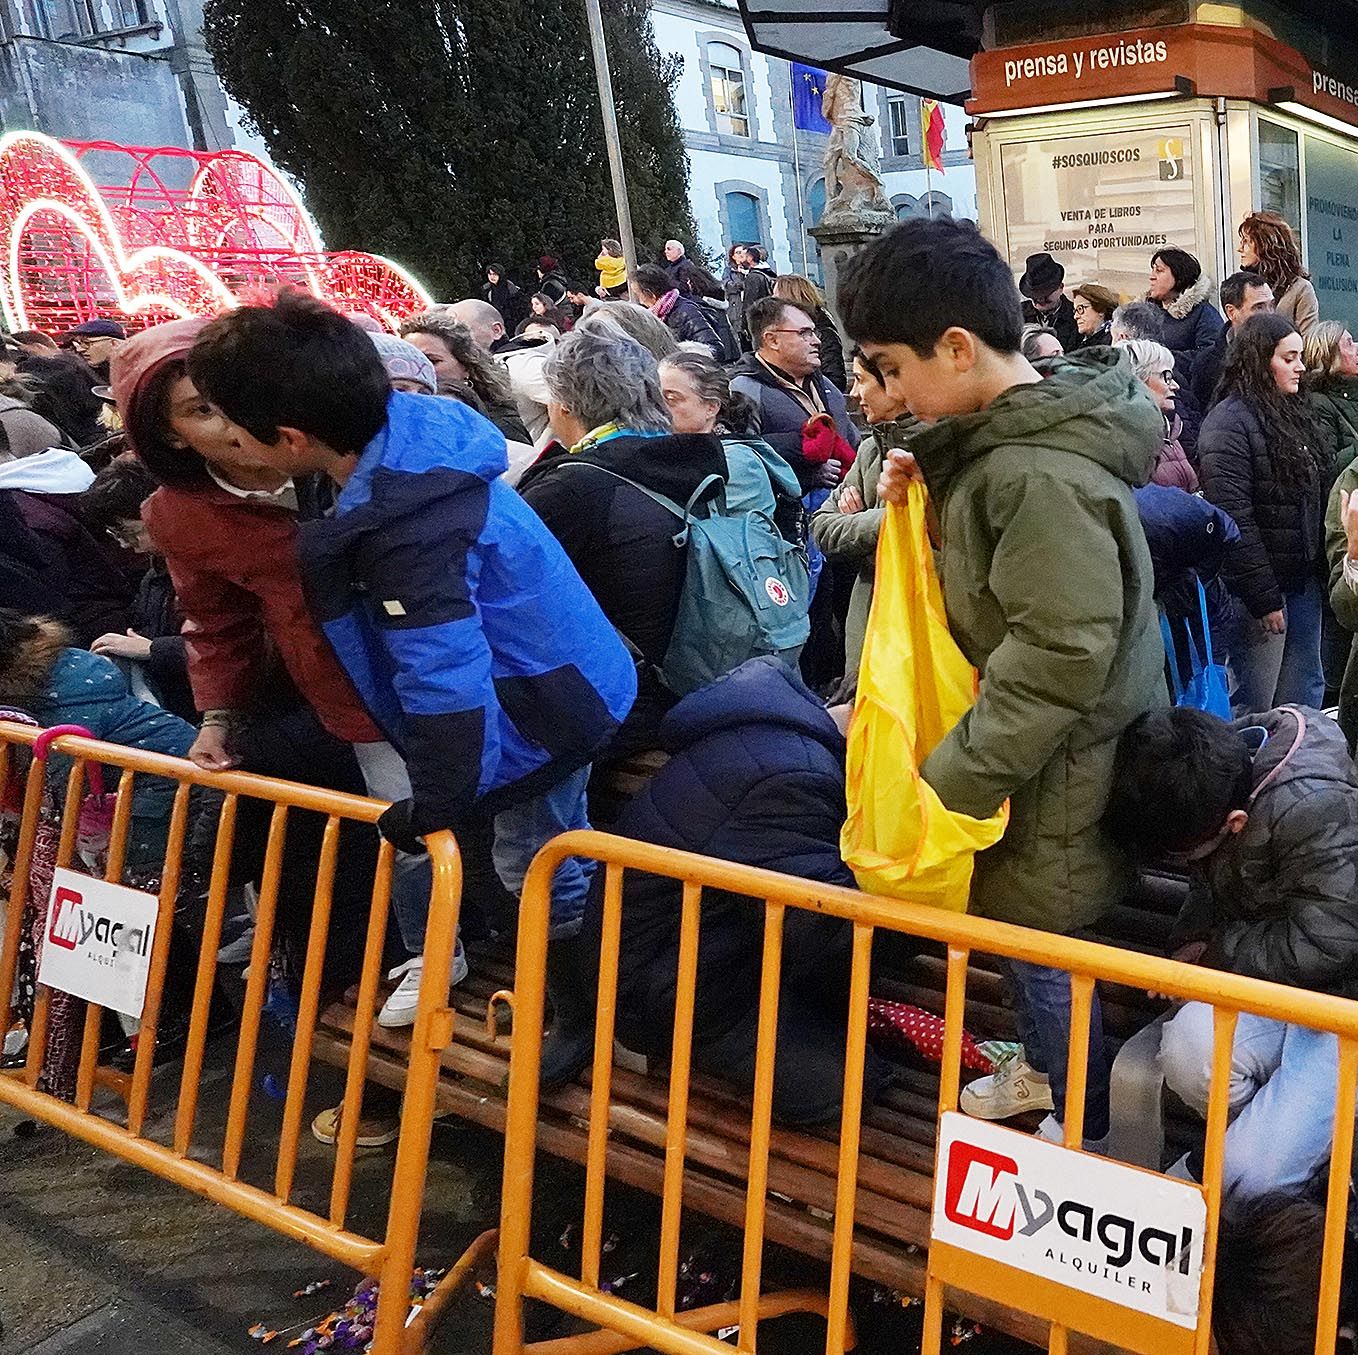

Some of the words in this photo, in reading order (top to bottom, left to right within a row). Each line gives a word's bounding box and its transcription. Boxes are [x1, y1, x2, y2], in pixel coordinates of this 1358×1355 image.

[1005, 53, 1068, 87] prensa
[1073, 51, 1084, 78] y
[1090, 39, 1167, 69] revistas
[1052, 148, 1140, 169] #SOSQUIOSCOS
[1060, 210, 1092, 221] VENTA
[1094, 208, 1106, 219] DE
[1109, 206, 1141, 218] LIBROS
[1088, 223, 1115, 234] PARA
[1043, 239, 1089, 251] SEGUNDAS
[1092, 234, 1167, 249] OPORTUNIDADES
[954, 1160, 1193, 1276] Myagal
[1045, 1248, 1152, 1294] ALQUILER
